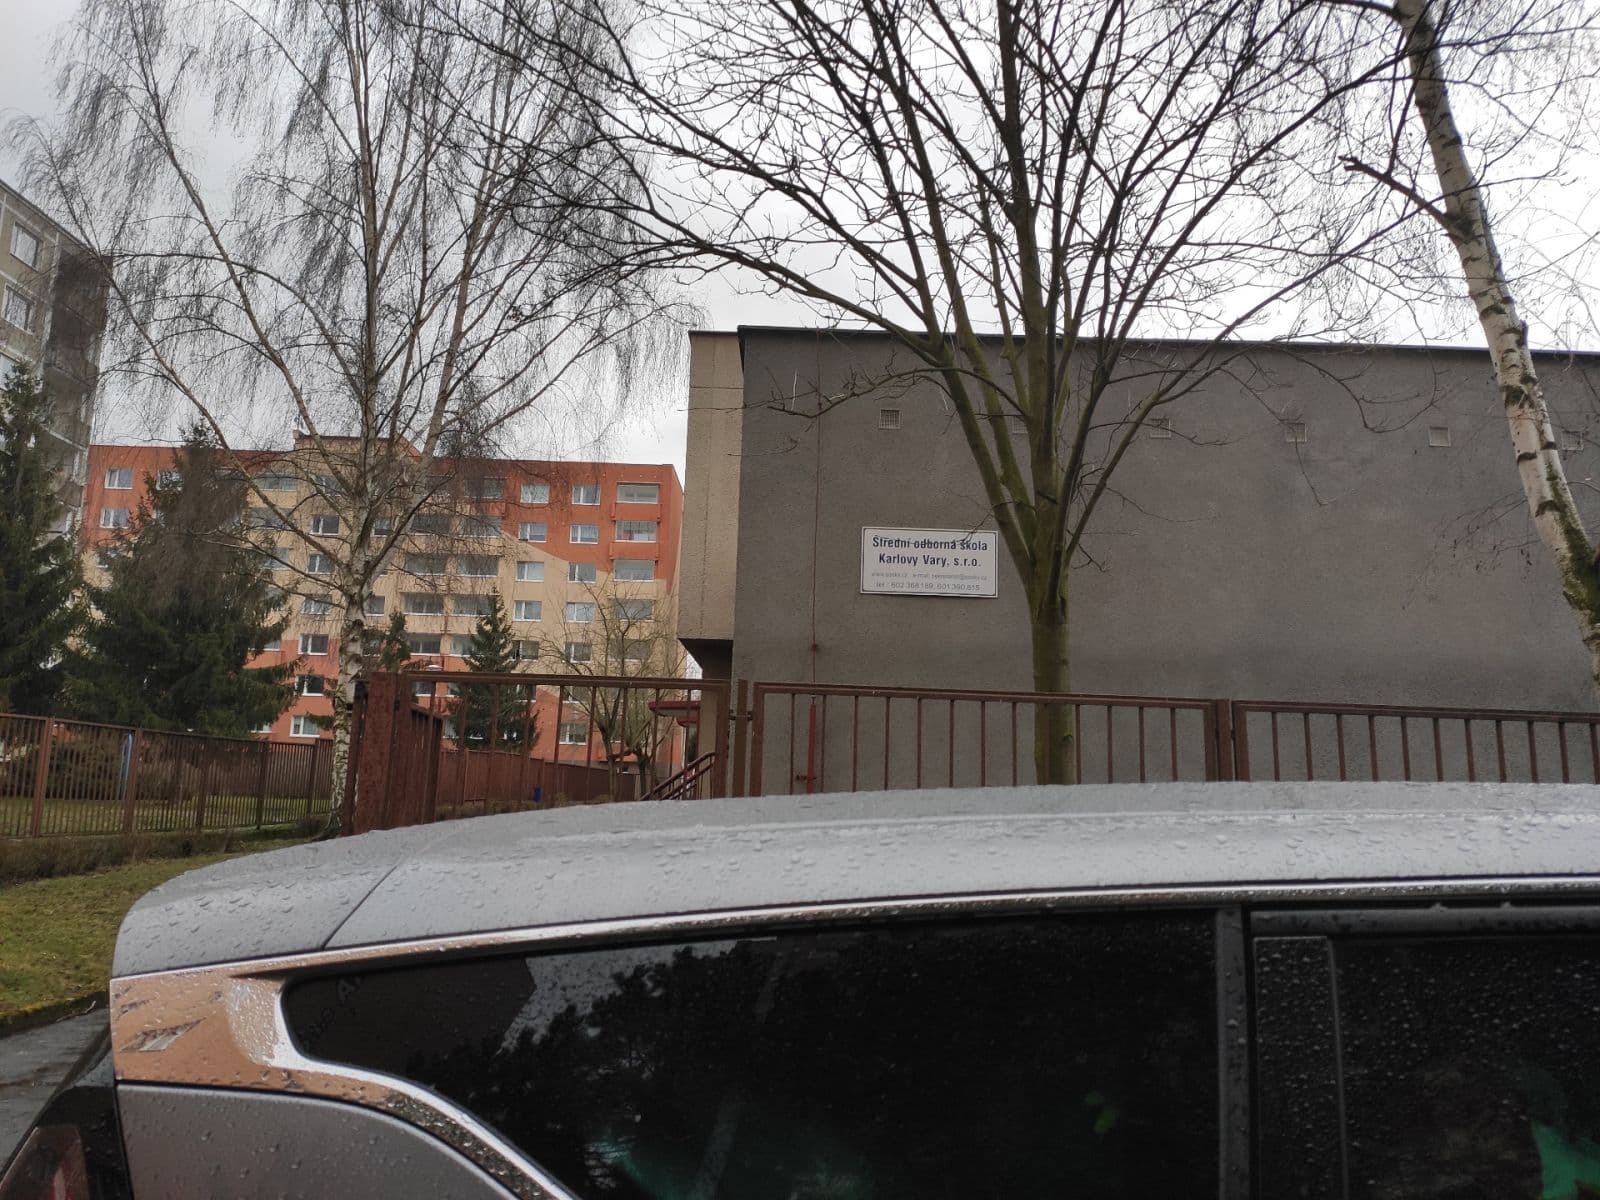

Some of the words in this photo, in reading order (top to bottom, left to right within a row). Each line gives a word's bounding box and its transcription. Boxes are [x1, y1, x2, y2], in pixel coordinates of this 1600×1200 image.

[913, 538, 957, 550] odborná
[959, 539, 988, 551] škola
[879, 553, 918, 566] Karlovy
[953, 557, 982, 567] s.r.o.
